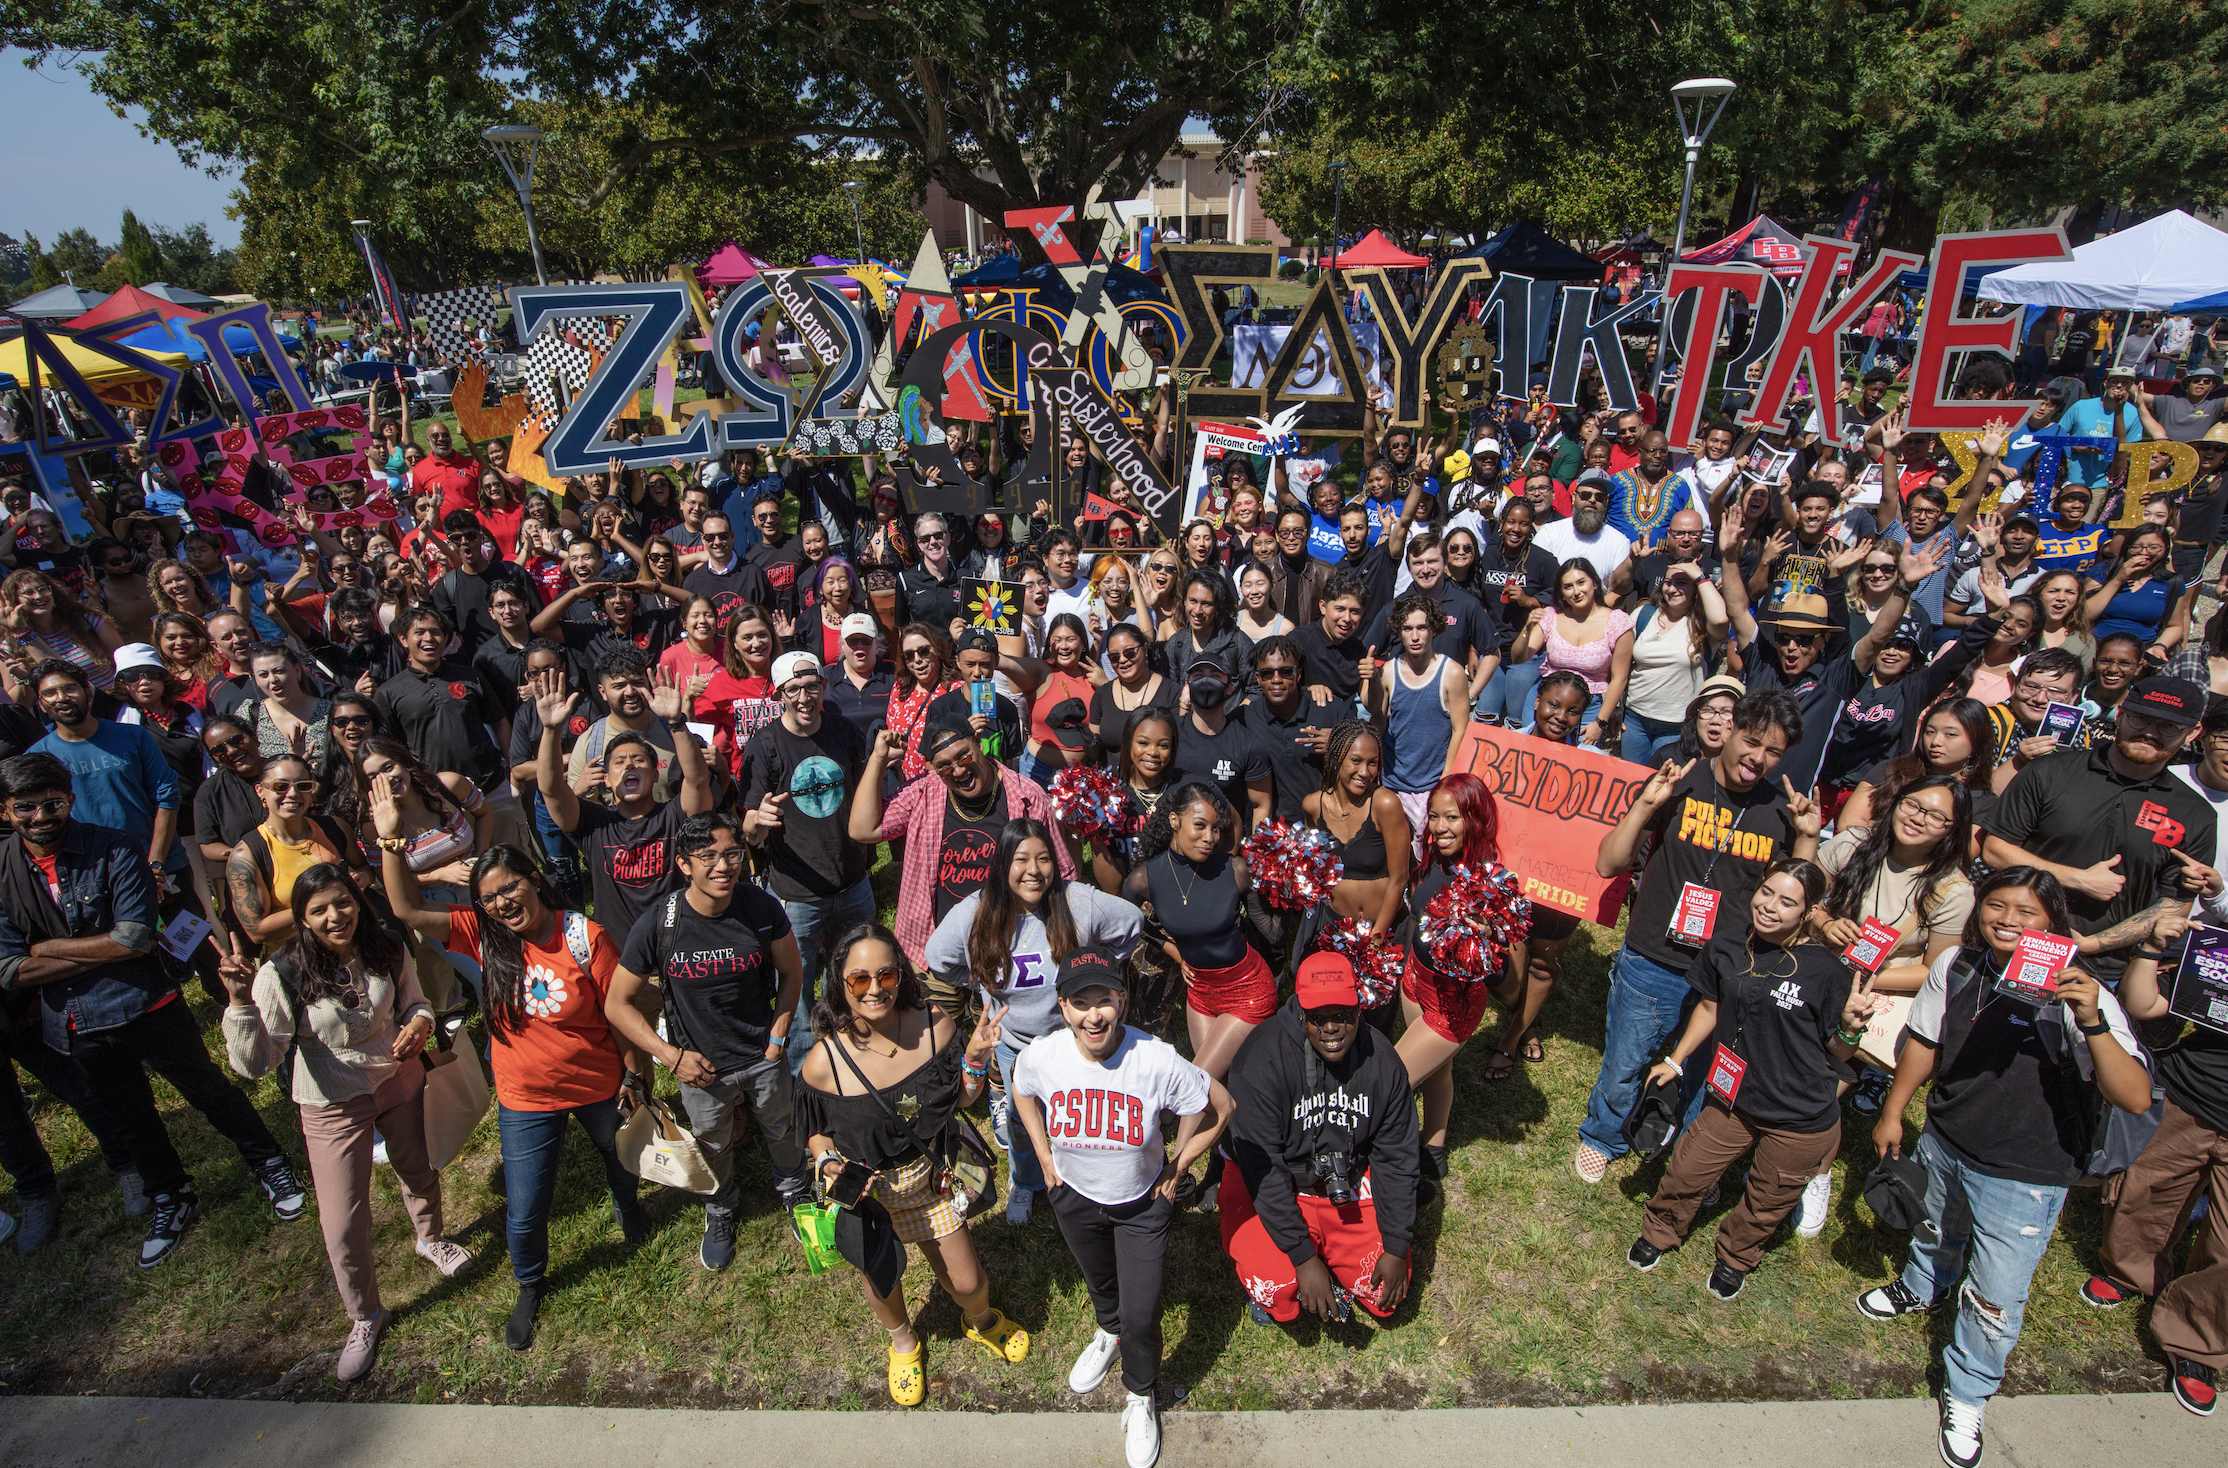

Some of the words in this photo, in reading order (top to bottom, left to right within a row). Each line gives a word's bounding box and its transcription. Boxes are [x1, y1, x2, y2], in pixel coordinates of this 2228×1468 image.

[1753, 237, 1801, 260] EB
[1769, 264, 1803, 274] IONEERS
[763, 269, 841, 367] Academics
[1055, 370, 1181, 518] Sisterhood
[1207, 434, 1245, 449] Welcome
[767, 565, 795, 579] FOREVER
[716, 597, 746, 616] rever
[993, 626, 1015, 636] CSUEB
[2143, 694, 2184, 708] Illustrated
[2150, 691, 2182, 702] Esports
[734, 702, 786, 721] STUDEN
[69, 751, 131, 776] ARLESS
[1685, 797, 1733, 828] PULP
[1678, 814, 1775, 863] FICTION
[613, 841, 664, 865] FOREVER
[613, 857, 664, 880] PIONEER
[941, 863, 991, 887] Pione
[1524, 876, 1590, 913] PRIDE
[1685, 896, 1715, 908] VALDEZ
[1689, 889, 1714, 901] JESUS
[664, 893, 678, 928] Reebo
[1863, 929, 1888, 945] STAFF
[1864, 923, 1895, 943] VOLUNTEER
[2019, 940, 2068, 956] LAMINERO
[2022, 935, 2069, 951] JENNALYN
[671, 951, 690, 963] AL
[692, 948, 735, 962] STATE
[2194, 955, 2228, 973] ESP
[667, 959, 724, 979] EAST
[1770, 988, 1786, 1000] FALL
[1785, 994, 1805, 1008] RUSH
[1775, 999, 1793, 1011] 2023
[1718, 1050, 1743, 1072] VOLUNTEER
[1719, 1057, 1739, 1074] STAFF
[1049, 1088, 1143, 1147] CSUEB
[1062, 1141, 1124, 1151] PIONEERS
[655, 1152, 670, 1166] EY
